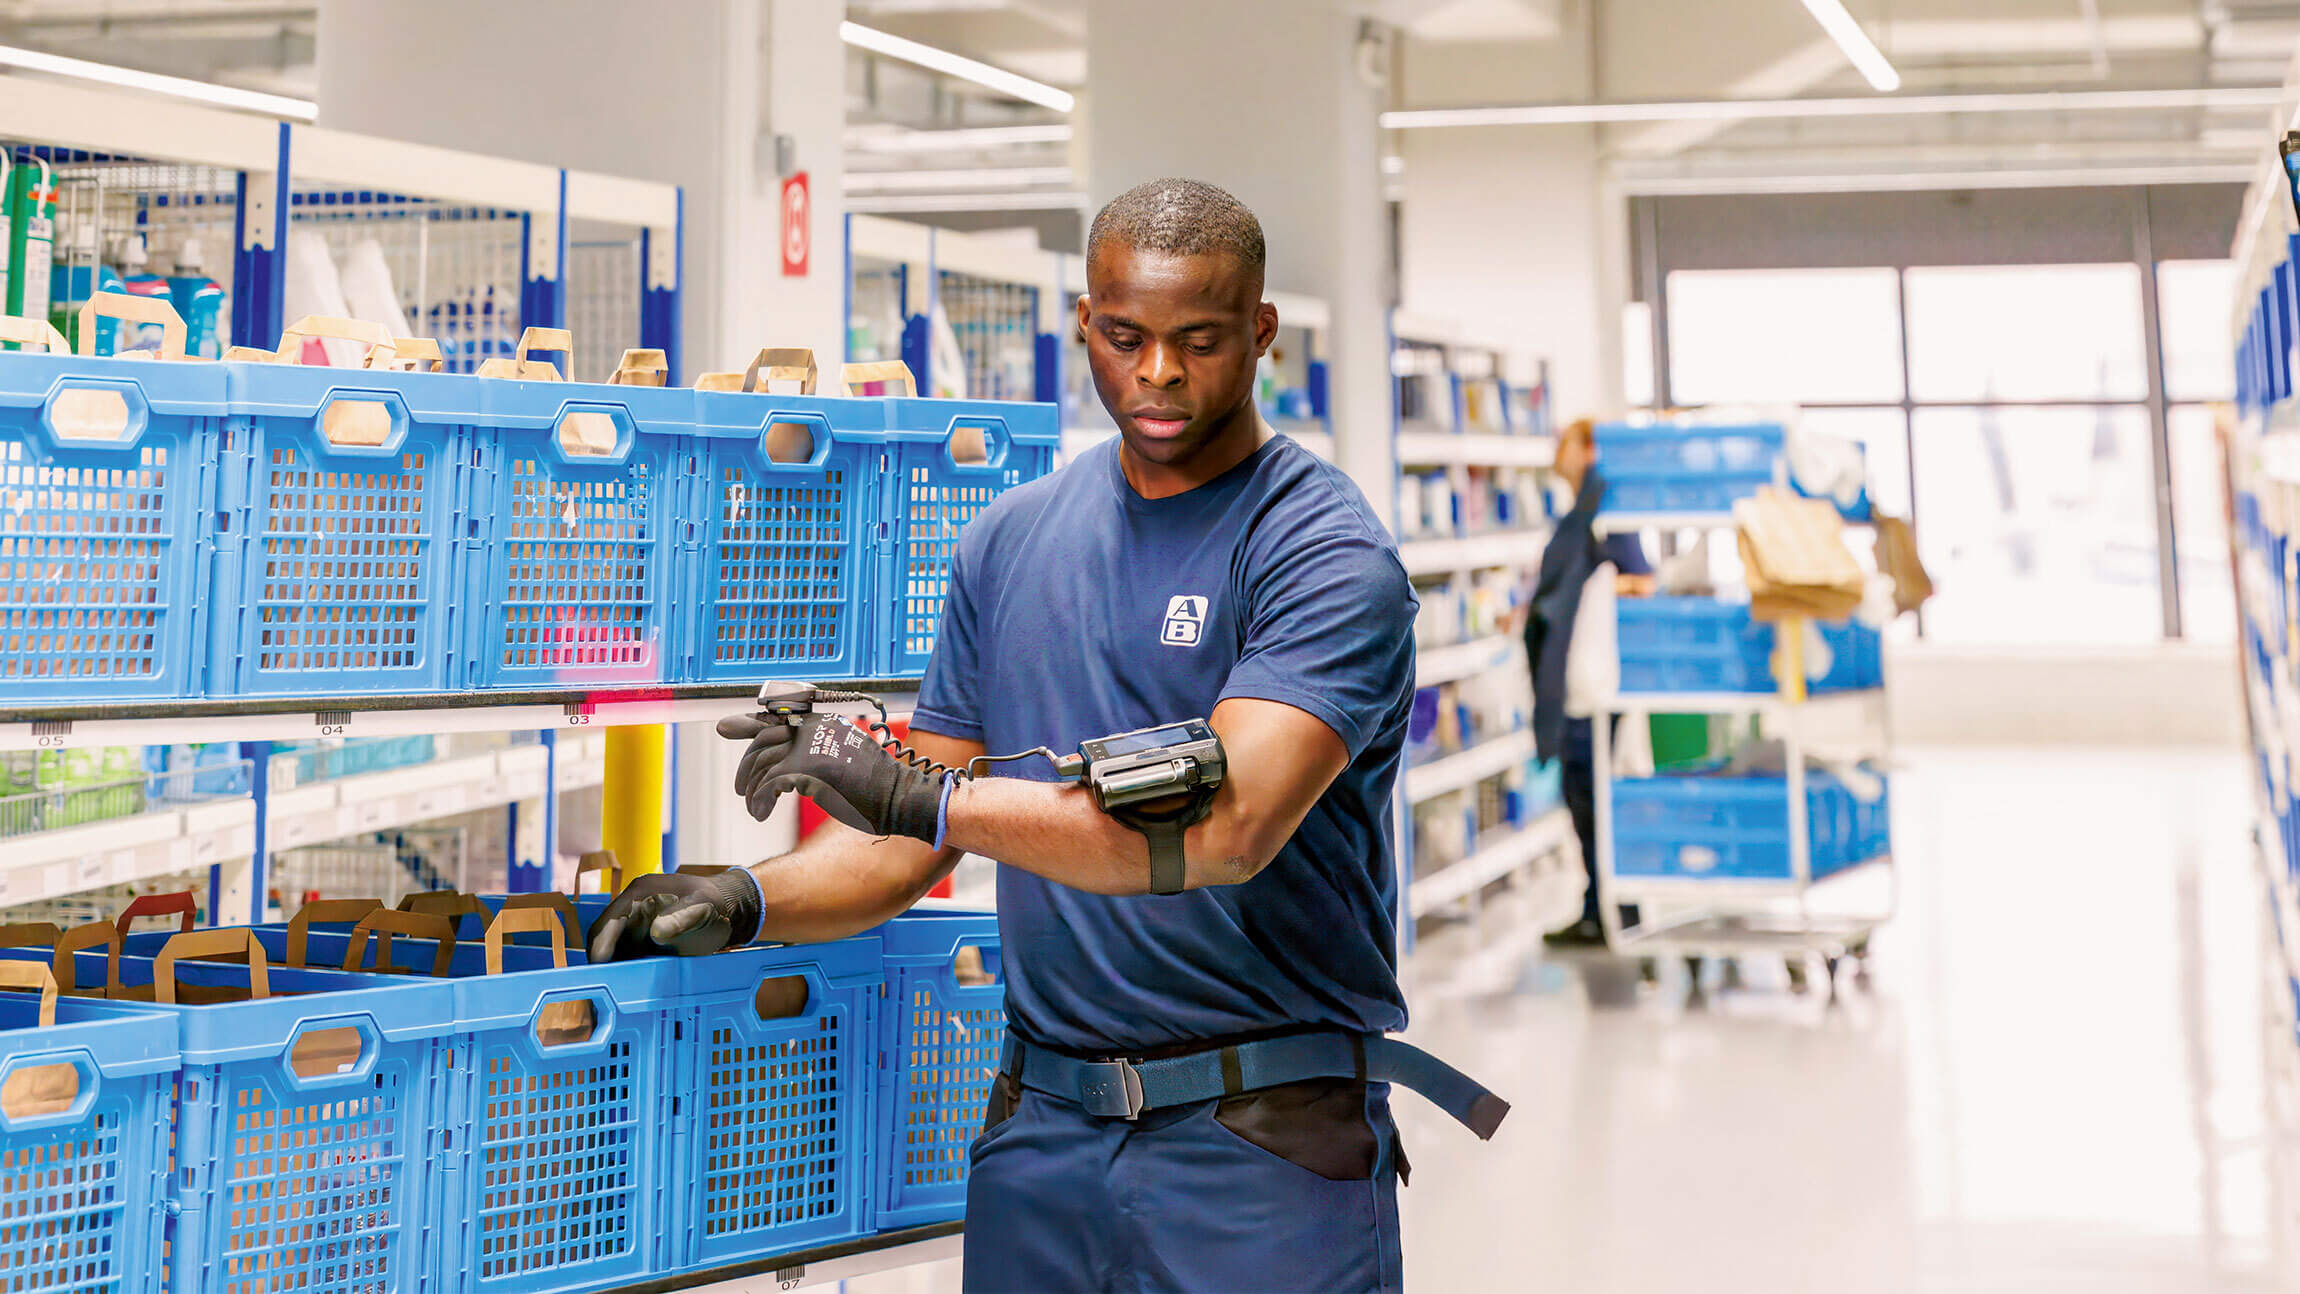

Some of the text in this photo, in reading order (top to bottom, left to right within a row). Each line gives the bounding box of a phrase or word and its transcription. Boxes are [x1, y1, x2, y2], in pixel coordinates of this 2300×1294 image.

[569, 715, 590, 725] 03
[321, 725, 345, 736] 04
[38, 735, 64, 747] 05
[781, 1279, 800, 1291] 07
